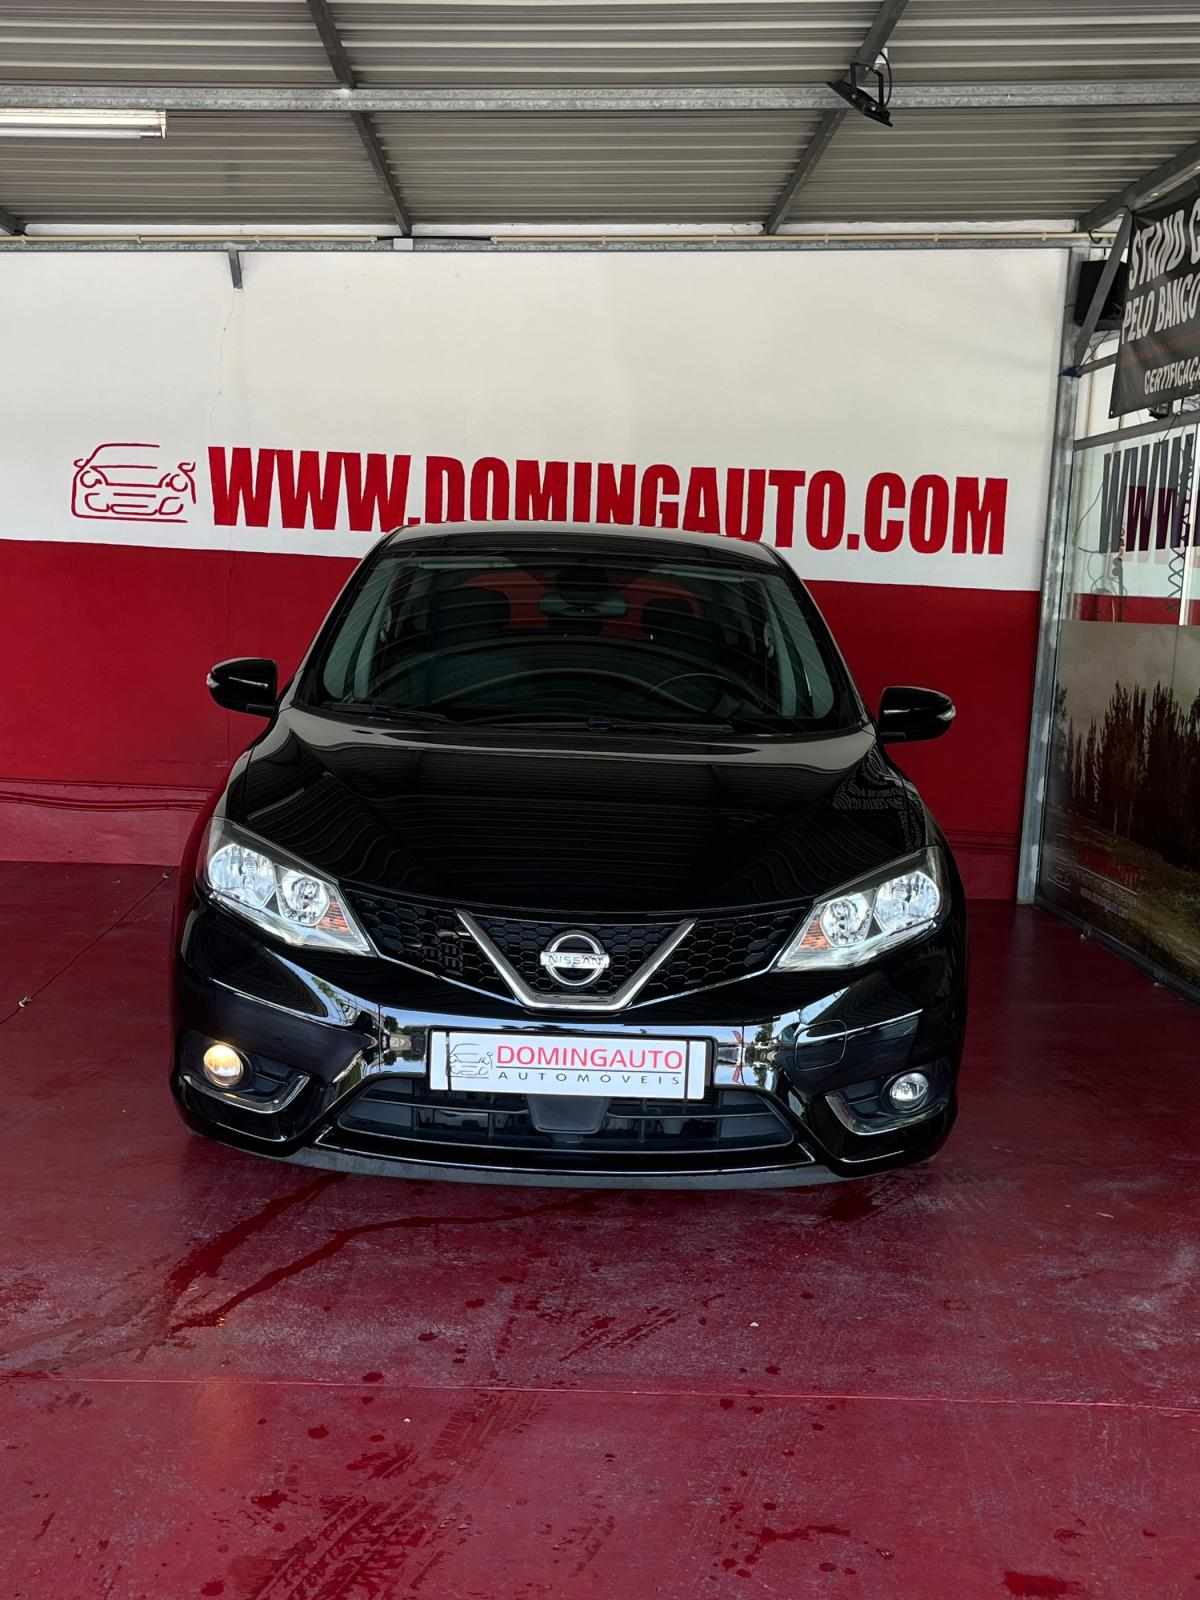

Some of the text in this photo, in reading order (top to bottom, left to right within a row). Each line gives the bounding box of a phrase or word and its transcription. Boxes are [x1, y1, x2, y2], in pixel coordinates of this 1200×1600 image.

[1128, 209, 1184, 290] STAND
[1121, 290, 1155, 345] PELO
[548, 954, 603, 966] NISSAN
[496, 1045, 683, 1069] DOMINGAUTO
[498, 1071, 680, 1085] AUTOMOVEIS
